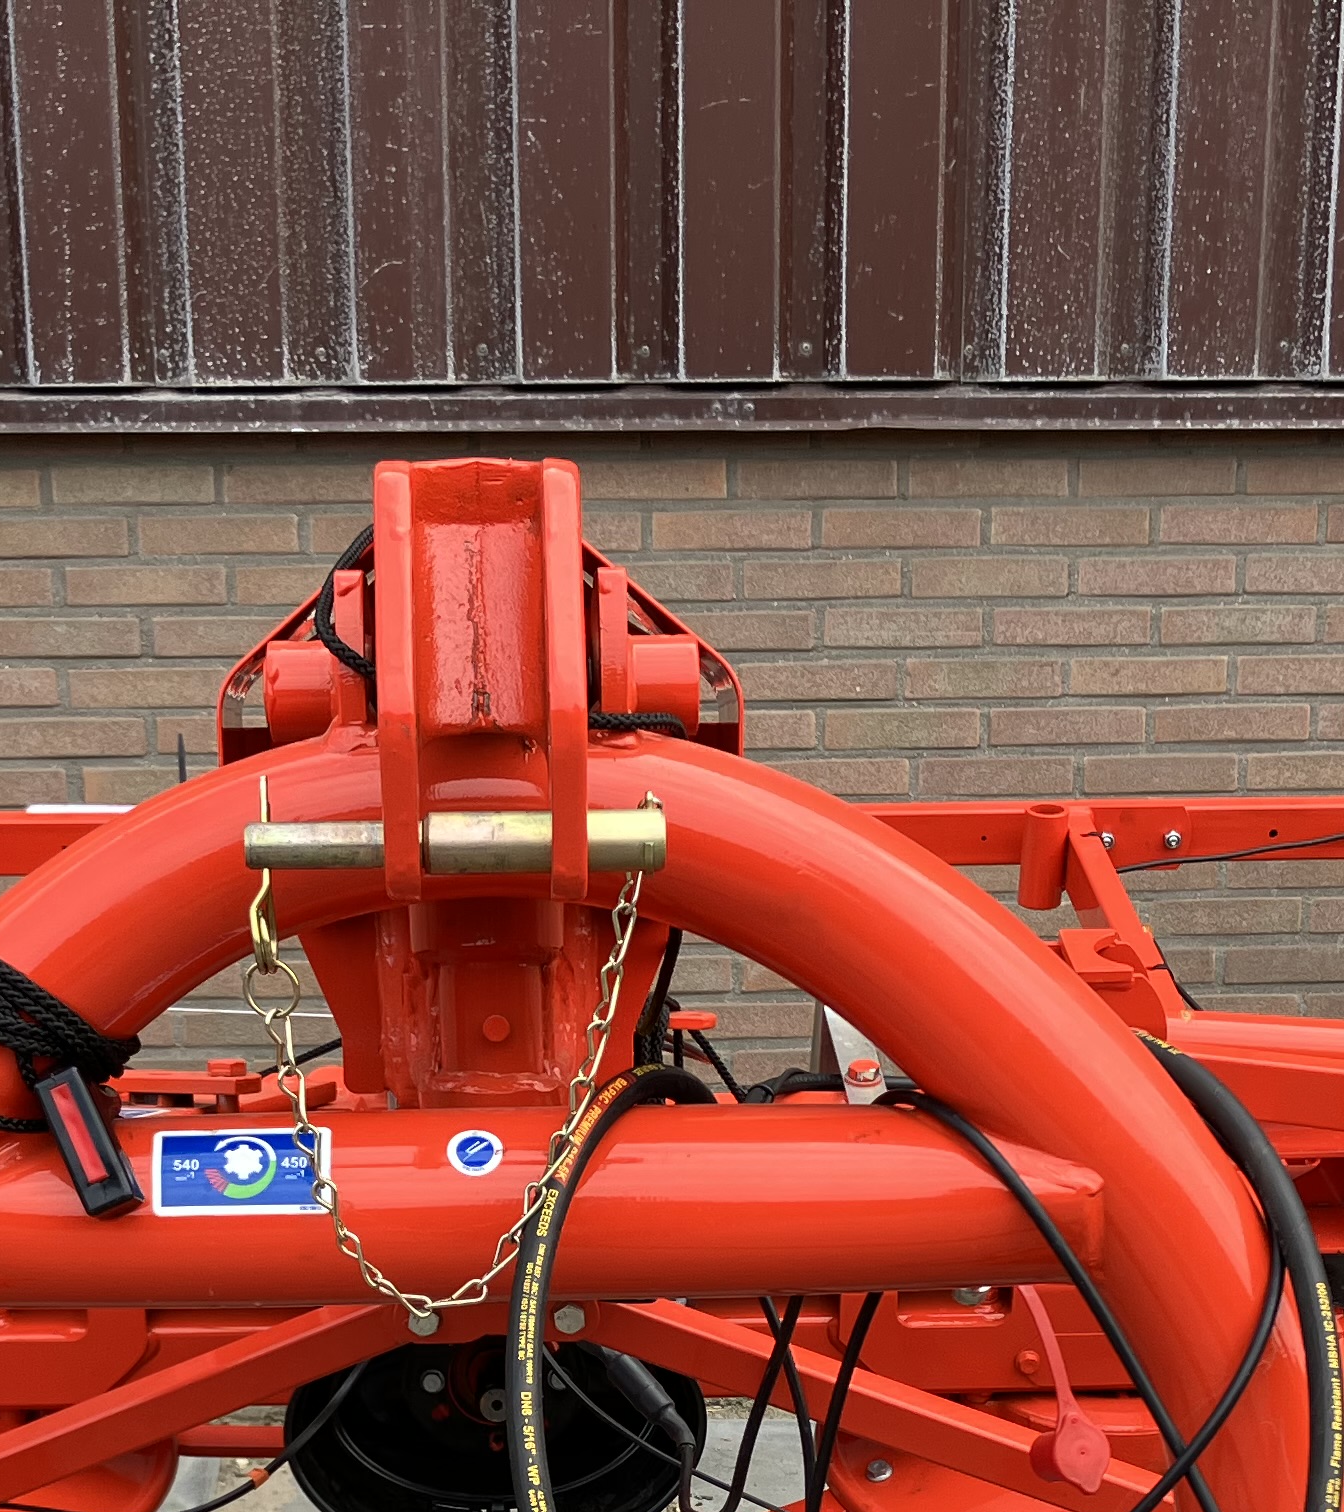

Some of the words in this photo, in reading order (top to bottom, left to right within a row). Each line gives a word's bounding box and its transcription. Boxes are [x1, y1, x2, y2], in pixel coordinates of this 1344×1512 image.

[599, 1078, 627, 1104] BALPAC
[573, 1105, 602, 1145] PREMIUM
[172, 1159, 200, 1171] 540
[280, 1156, 308, 1169] 450
[536, 1187, 559, 1237] EXCEEDS
[1331, 1377, 1342, 1431] Resistant
[1330, 1433, 1342, 1468] Flame
[528, 1464, 540, 1486] WP
